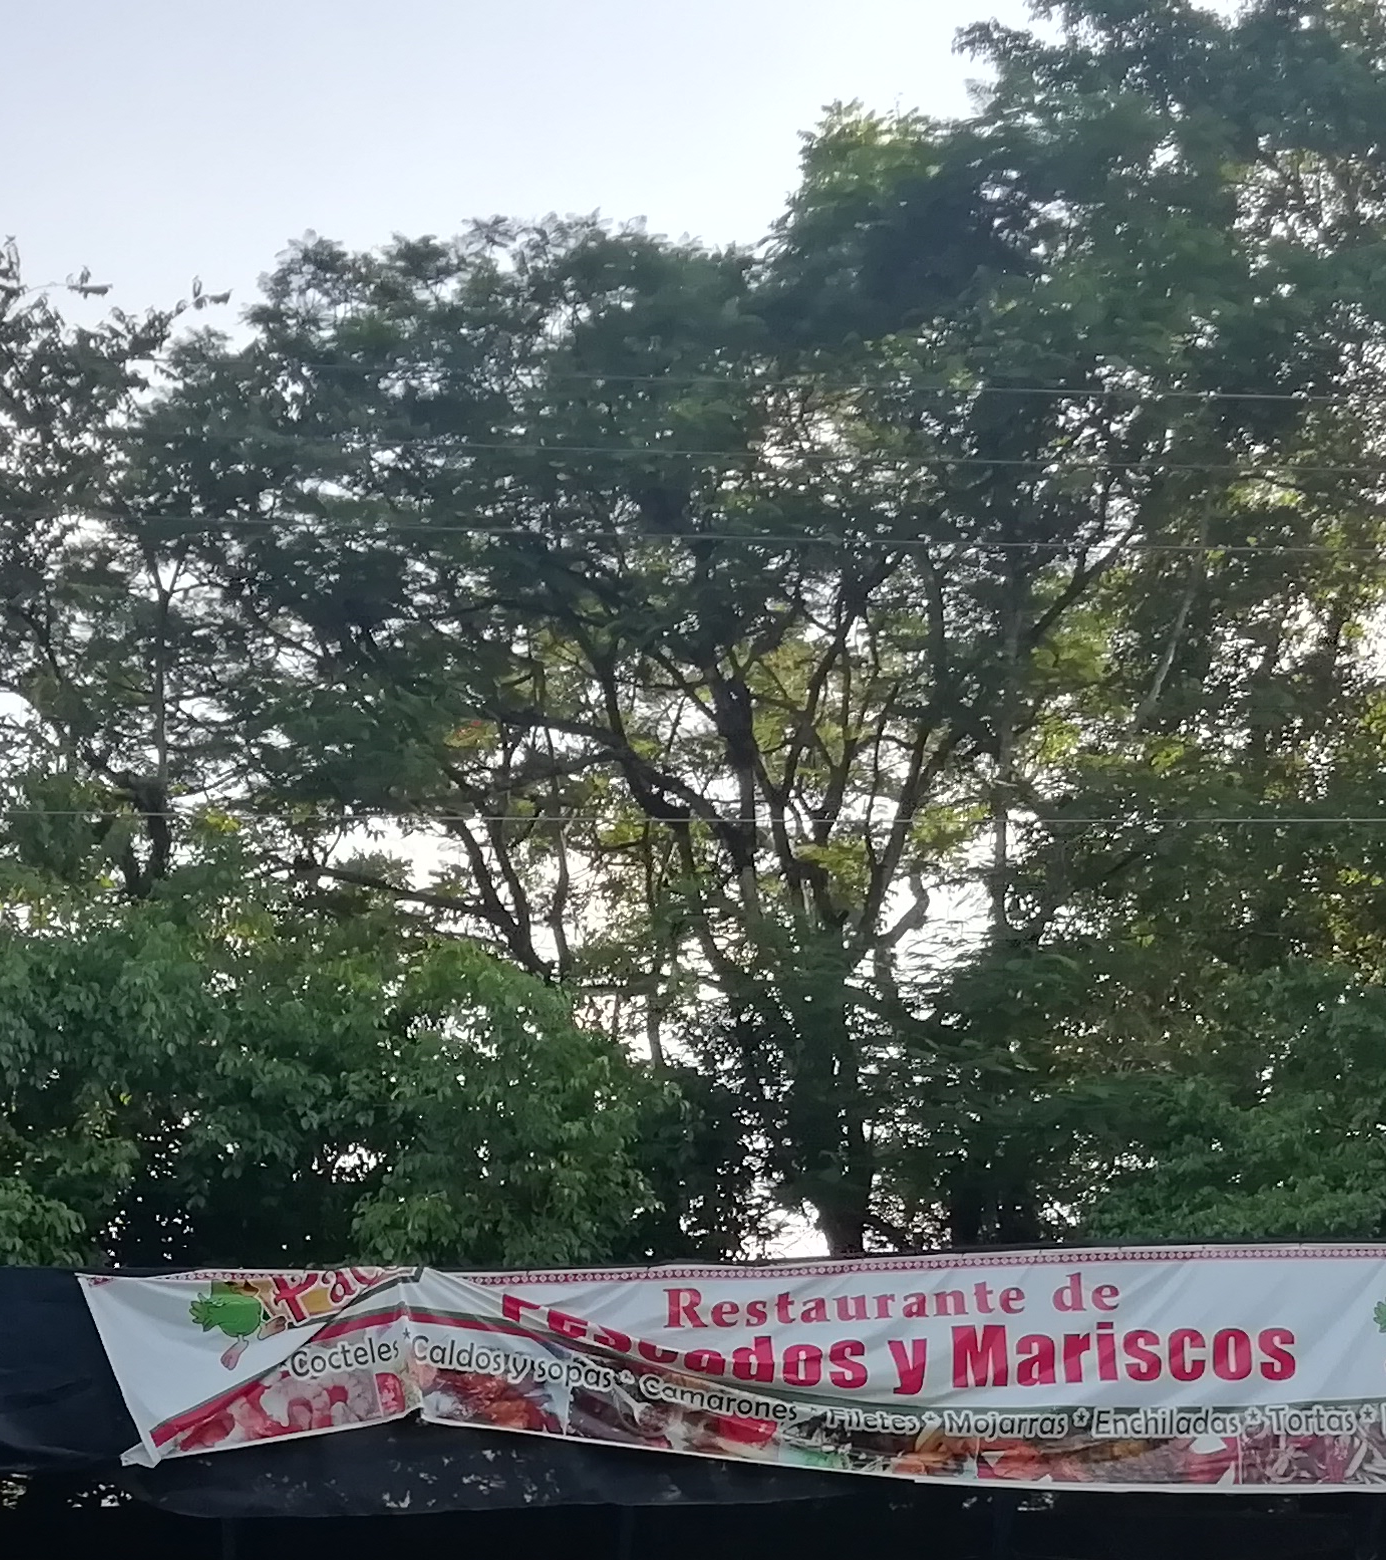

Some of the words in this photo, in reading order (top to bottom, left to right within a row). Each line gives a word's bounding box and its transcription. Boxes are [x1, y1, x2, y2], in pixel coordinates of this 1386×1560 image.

[663, 1281, 1025, 1329] Restaurante
[1053, 1271, 1120, 1312] de
[291, 1338, 399, 1377] Cocteles
[412, 1335, 501, 1371] Caldos
[512, 1357, 529, 1379] y
[537, 1361, 612, 1388] sopas
[644, 1375, 798, 1421] Camarones
[826, 1408, 919, 1433] Filetes
[946, 1411, 1065, 1438] Mojarras
[1094, 1409, 1239, 1436] Enchiladas
[1269, 1407, 1354, 1432] Tortas
[888, 1337, 928, 1395] y
[951, 1322, 1296, 1388] Mariscos
